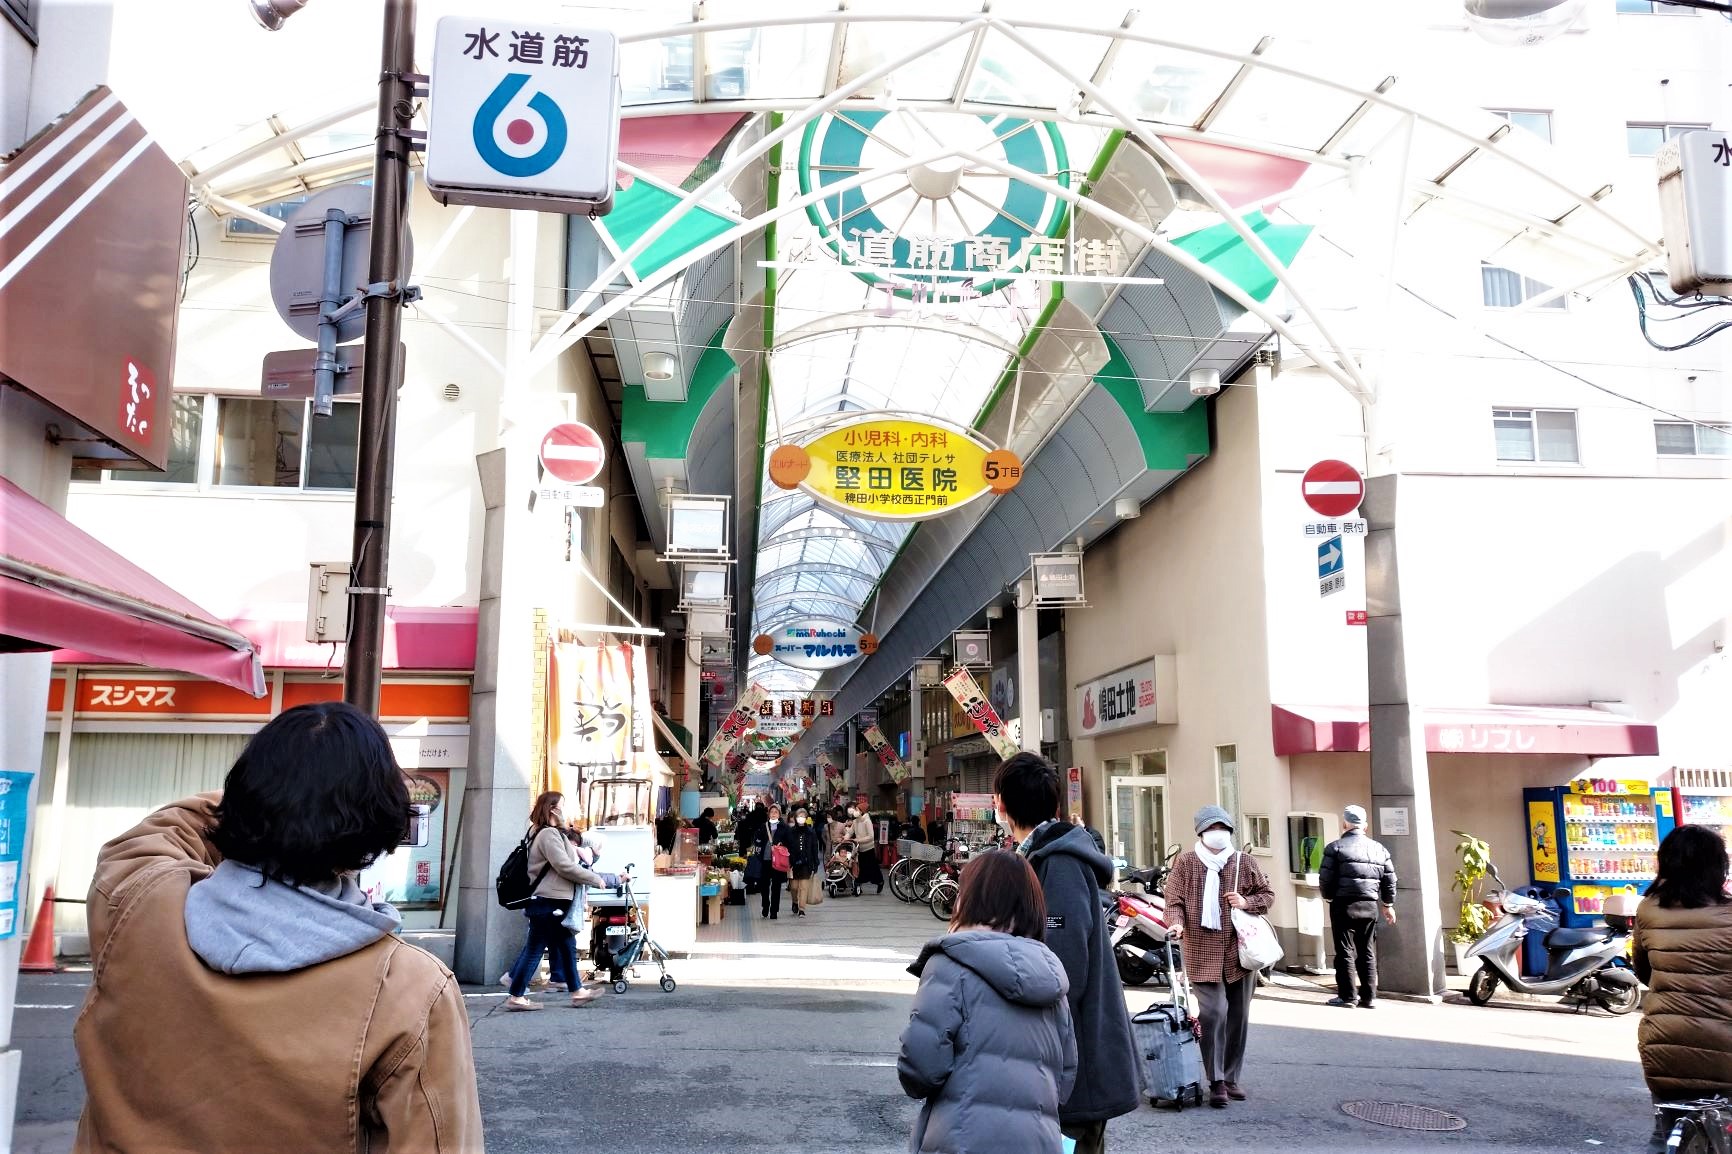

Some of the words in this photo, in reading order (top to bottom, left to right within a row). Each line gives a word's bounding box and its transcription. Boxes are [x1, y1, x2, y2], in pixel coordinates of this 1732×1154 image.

[463, 27, 589, 69] 水道筋
[473, 73, 567, 177] 6
[788, 225, 1121, 275] 水道筋商店街
[844, 430, 948, 448] 小児科・内科
[836, 450, 887, 464] 医療法人
[893, 453, 956, 465] 社団テレサ
[835, 465, 957, 492] 堅田医院
[985, 461, 1020, 480] 5丁目
[1305, 522, 1365, 535] 自動車・原付
[803, 644, 857, 657] マルハチ
[91, 685, 176, 706] スシマス
